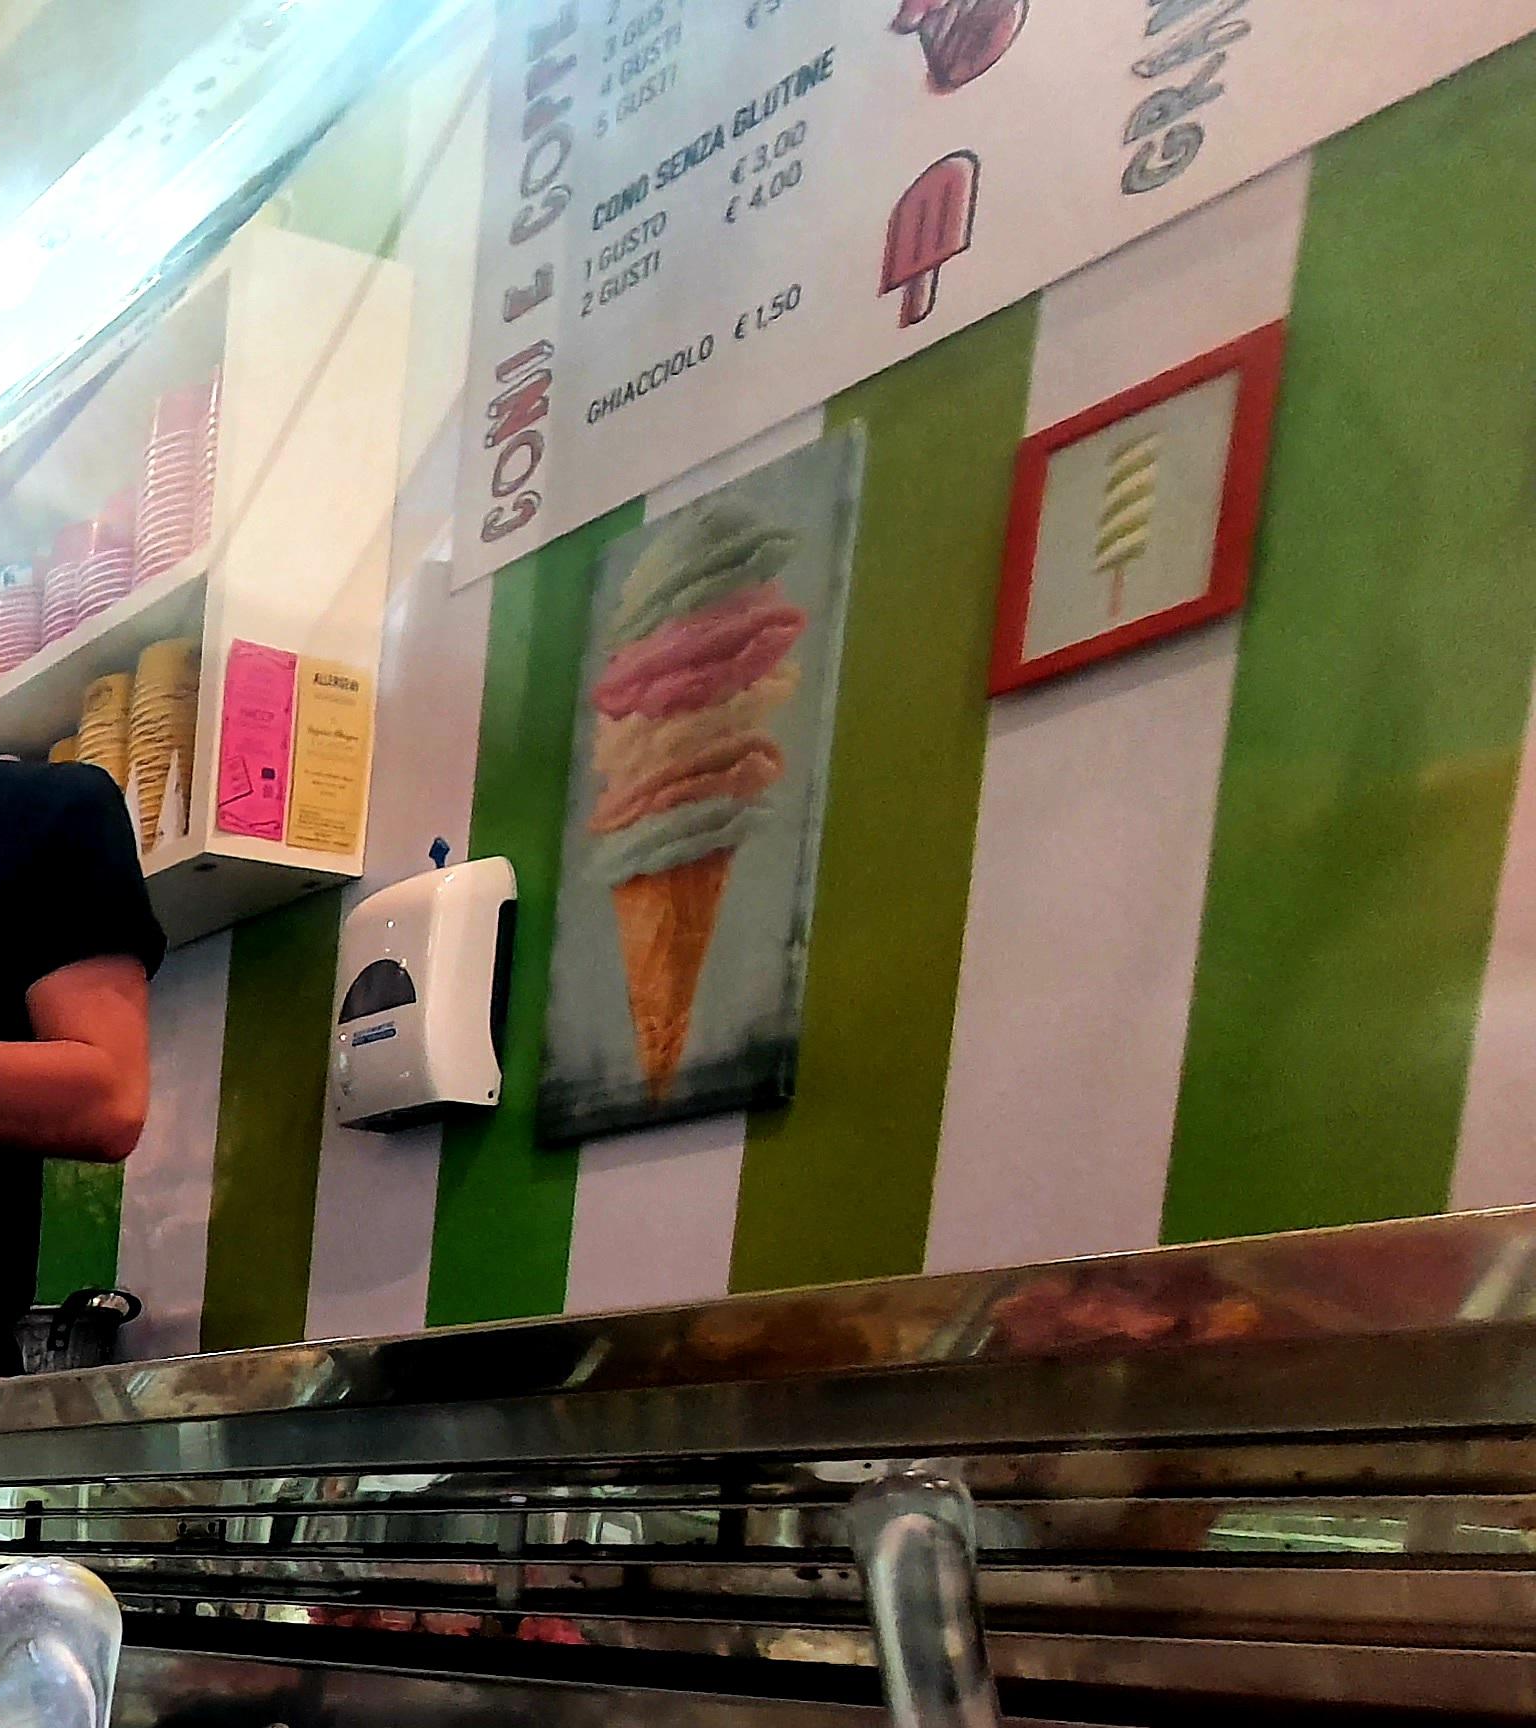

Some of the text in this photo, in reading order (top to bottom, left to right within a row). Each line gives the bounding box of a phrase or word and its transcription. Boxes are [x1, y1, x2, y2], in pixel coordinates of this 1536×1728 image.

[591, 44, 837, 232] CONO SENZA GLUTINE
[581, 292, 595, 320] 2
[597, 248, 662, 307] GUSTI
[584, 256, 593, 282] 1
[597, 210, 668, 272] GUSTO
[586, 333, 715, 426] GHIACCIOLO
[480, 338, 555, 544] CONI
